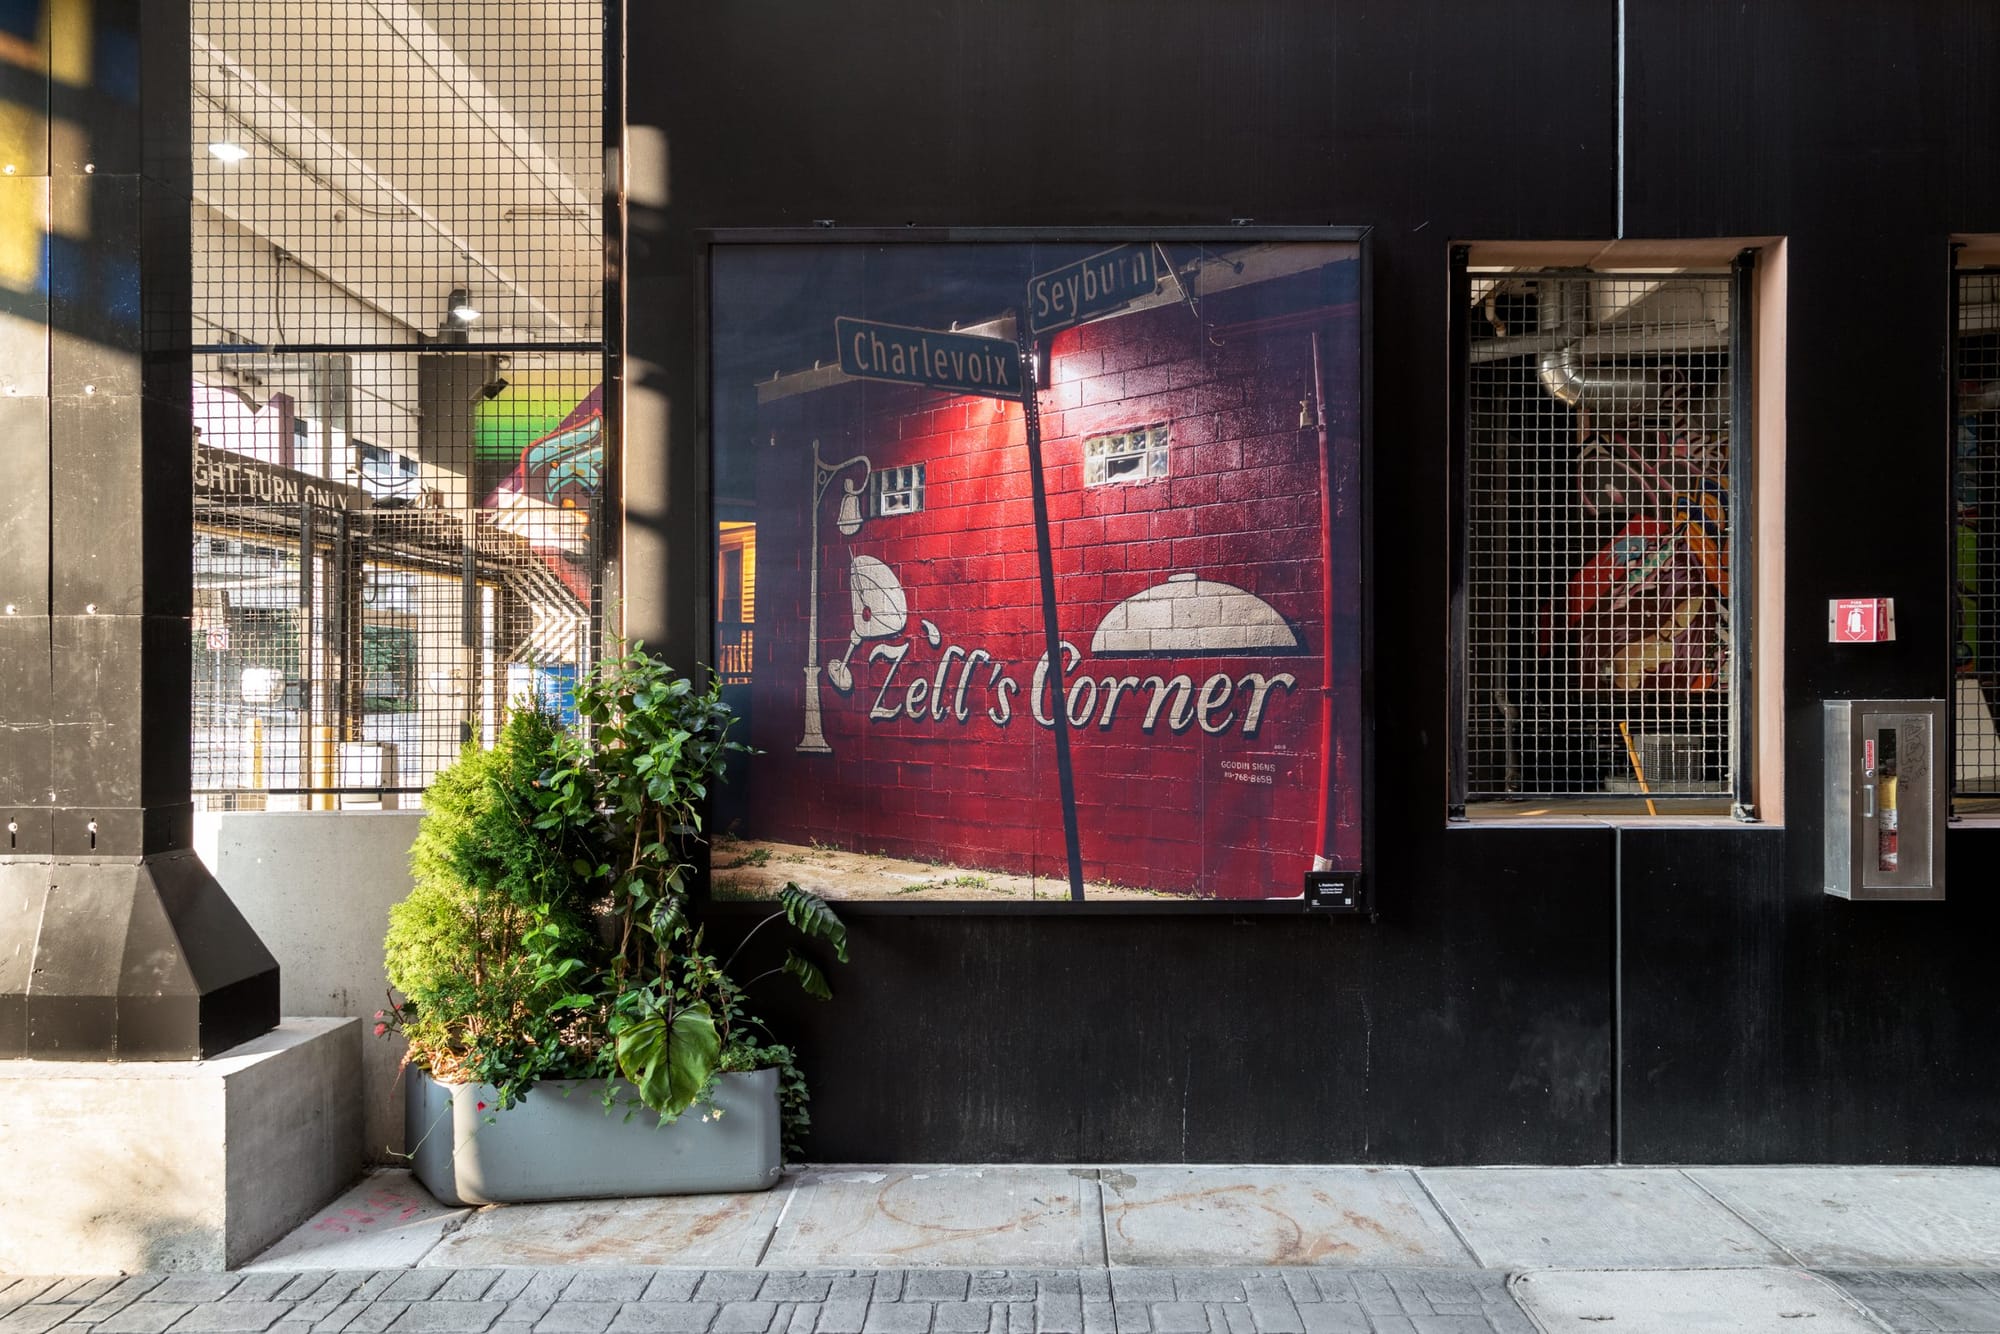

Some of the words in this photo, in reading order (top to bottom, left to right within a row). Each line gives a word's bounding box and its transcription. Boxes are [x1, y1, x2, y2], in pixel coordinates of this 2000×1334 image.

[1036, 251, 1147, 318] Seyburn
[853, 330, 1009, 387] Charlevoix
[244, 467, 299, 503] TURN
[868, 642, 1019, 726] Zell's
[1030, 640, 1297, 736] Corner
[1251, 762, 1276, 773] SIGNS
